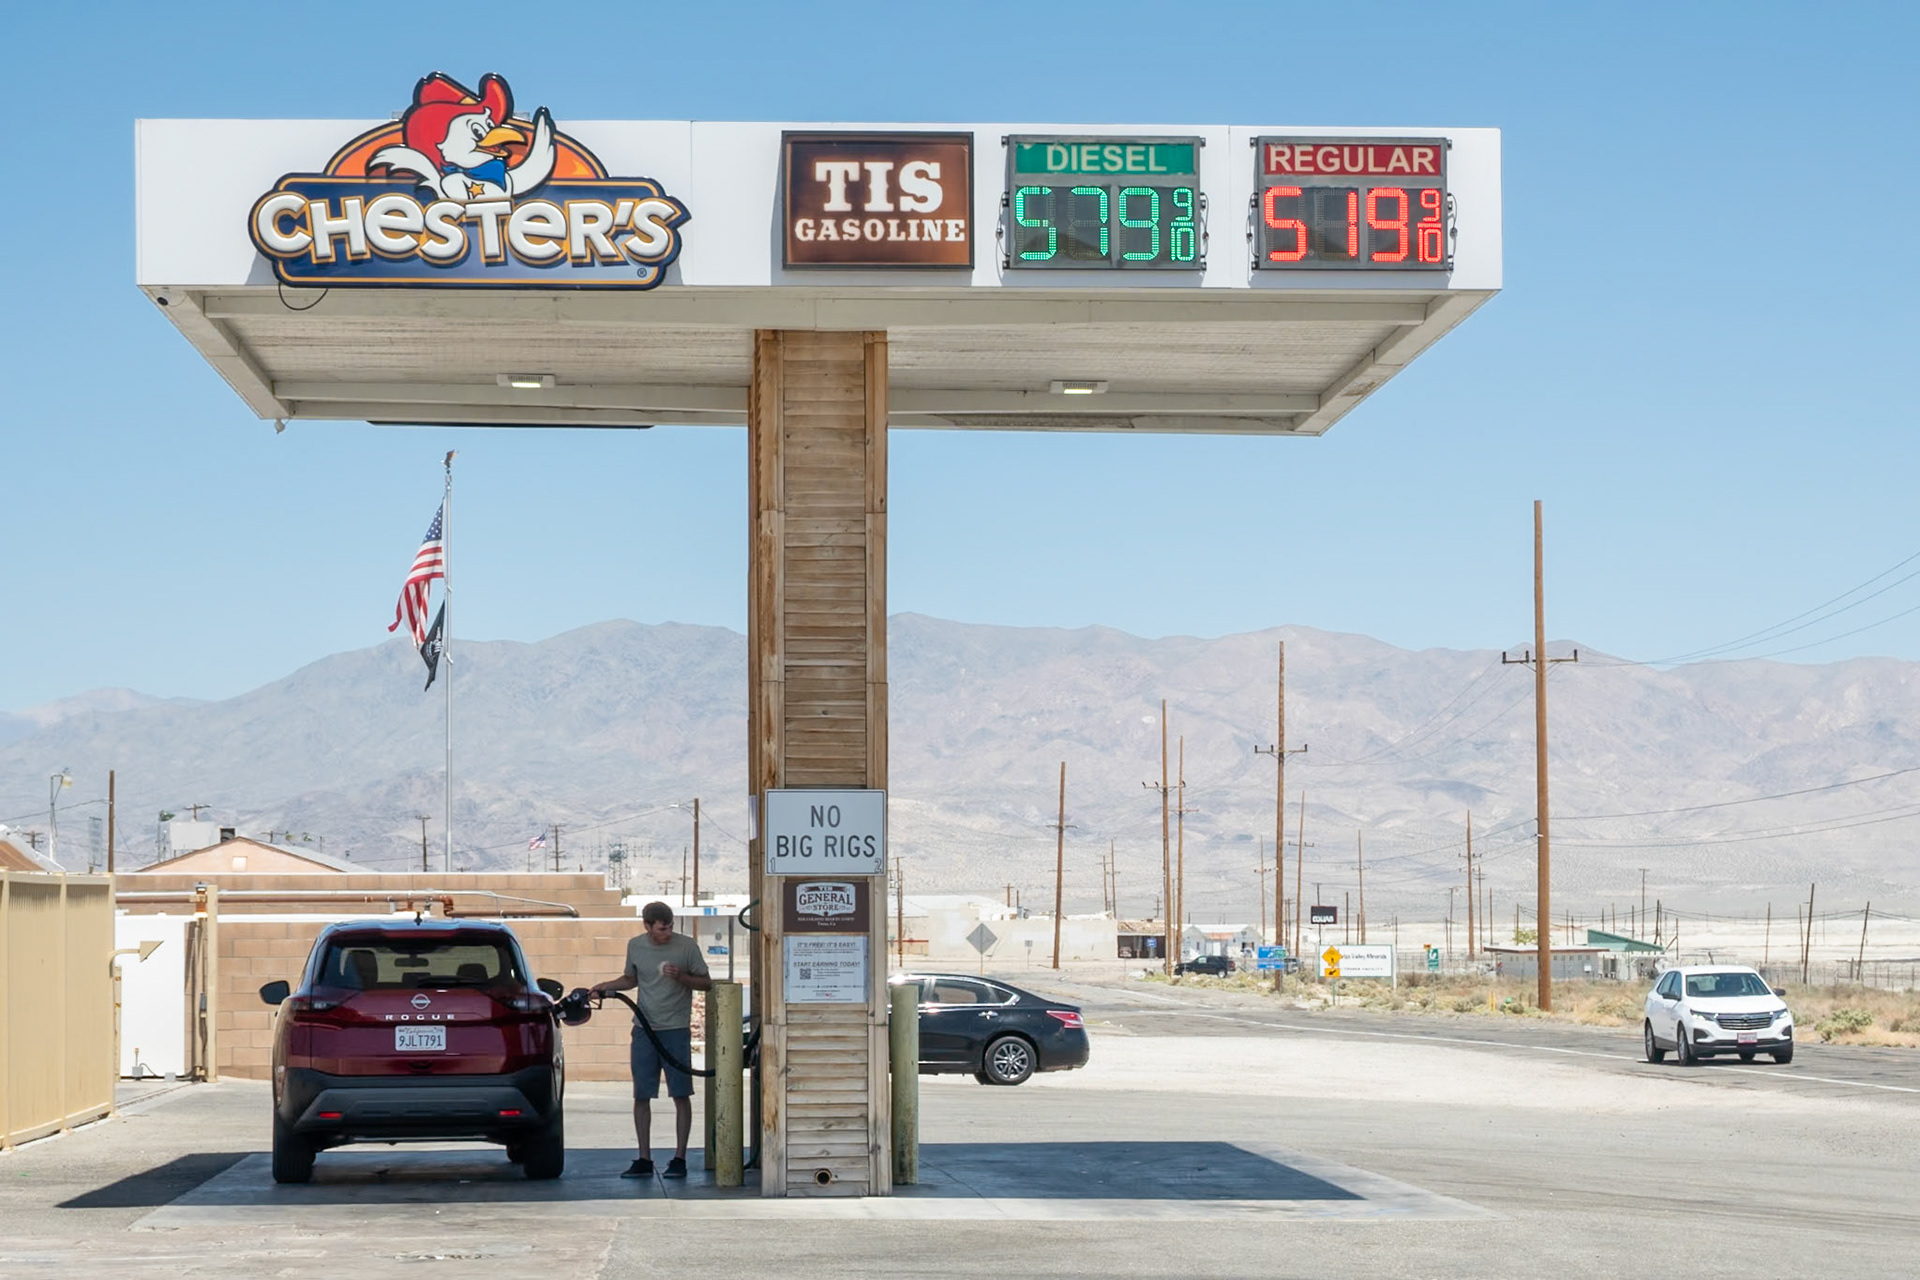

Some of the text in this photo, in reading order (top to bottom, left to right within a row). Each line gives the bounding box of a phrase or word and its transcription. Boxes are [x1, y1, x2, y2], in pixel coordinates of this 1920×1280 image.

[1047, 145, 1167, 172] DIESEL
[1269, 145, 1435, 173] REGULAR
[815, 161, 943, 213] TIS
[794, 219, 965, 242] GASOLINE
[1015, 186, 1160, 261] 579
[1264, 186, 1409, 263] 519
[811, 805, 841, 828] NO
[776, 834, 876, 858] BIG RIGS
[799, 892, 853, 906] GENERAL
[398, 1035, 443, 1048] 9JLT791
